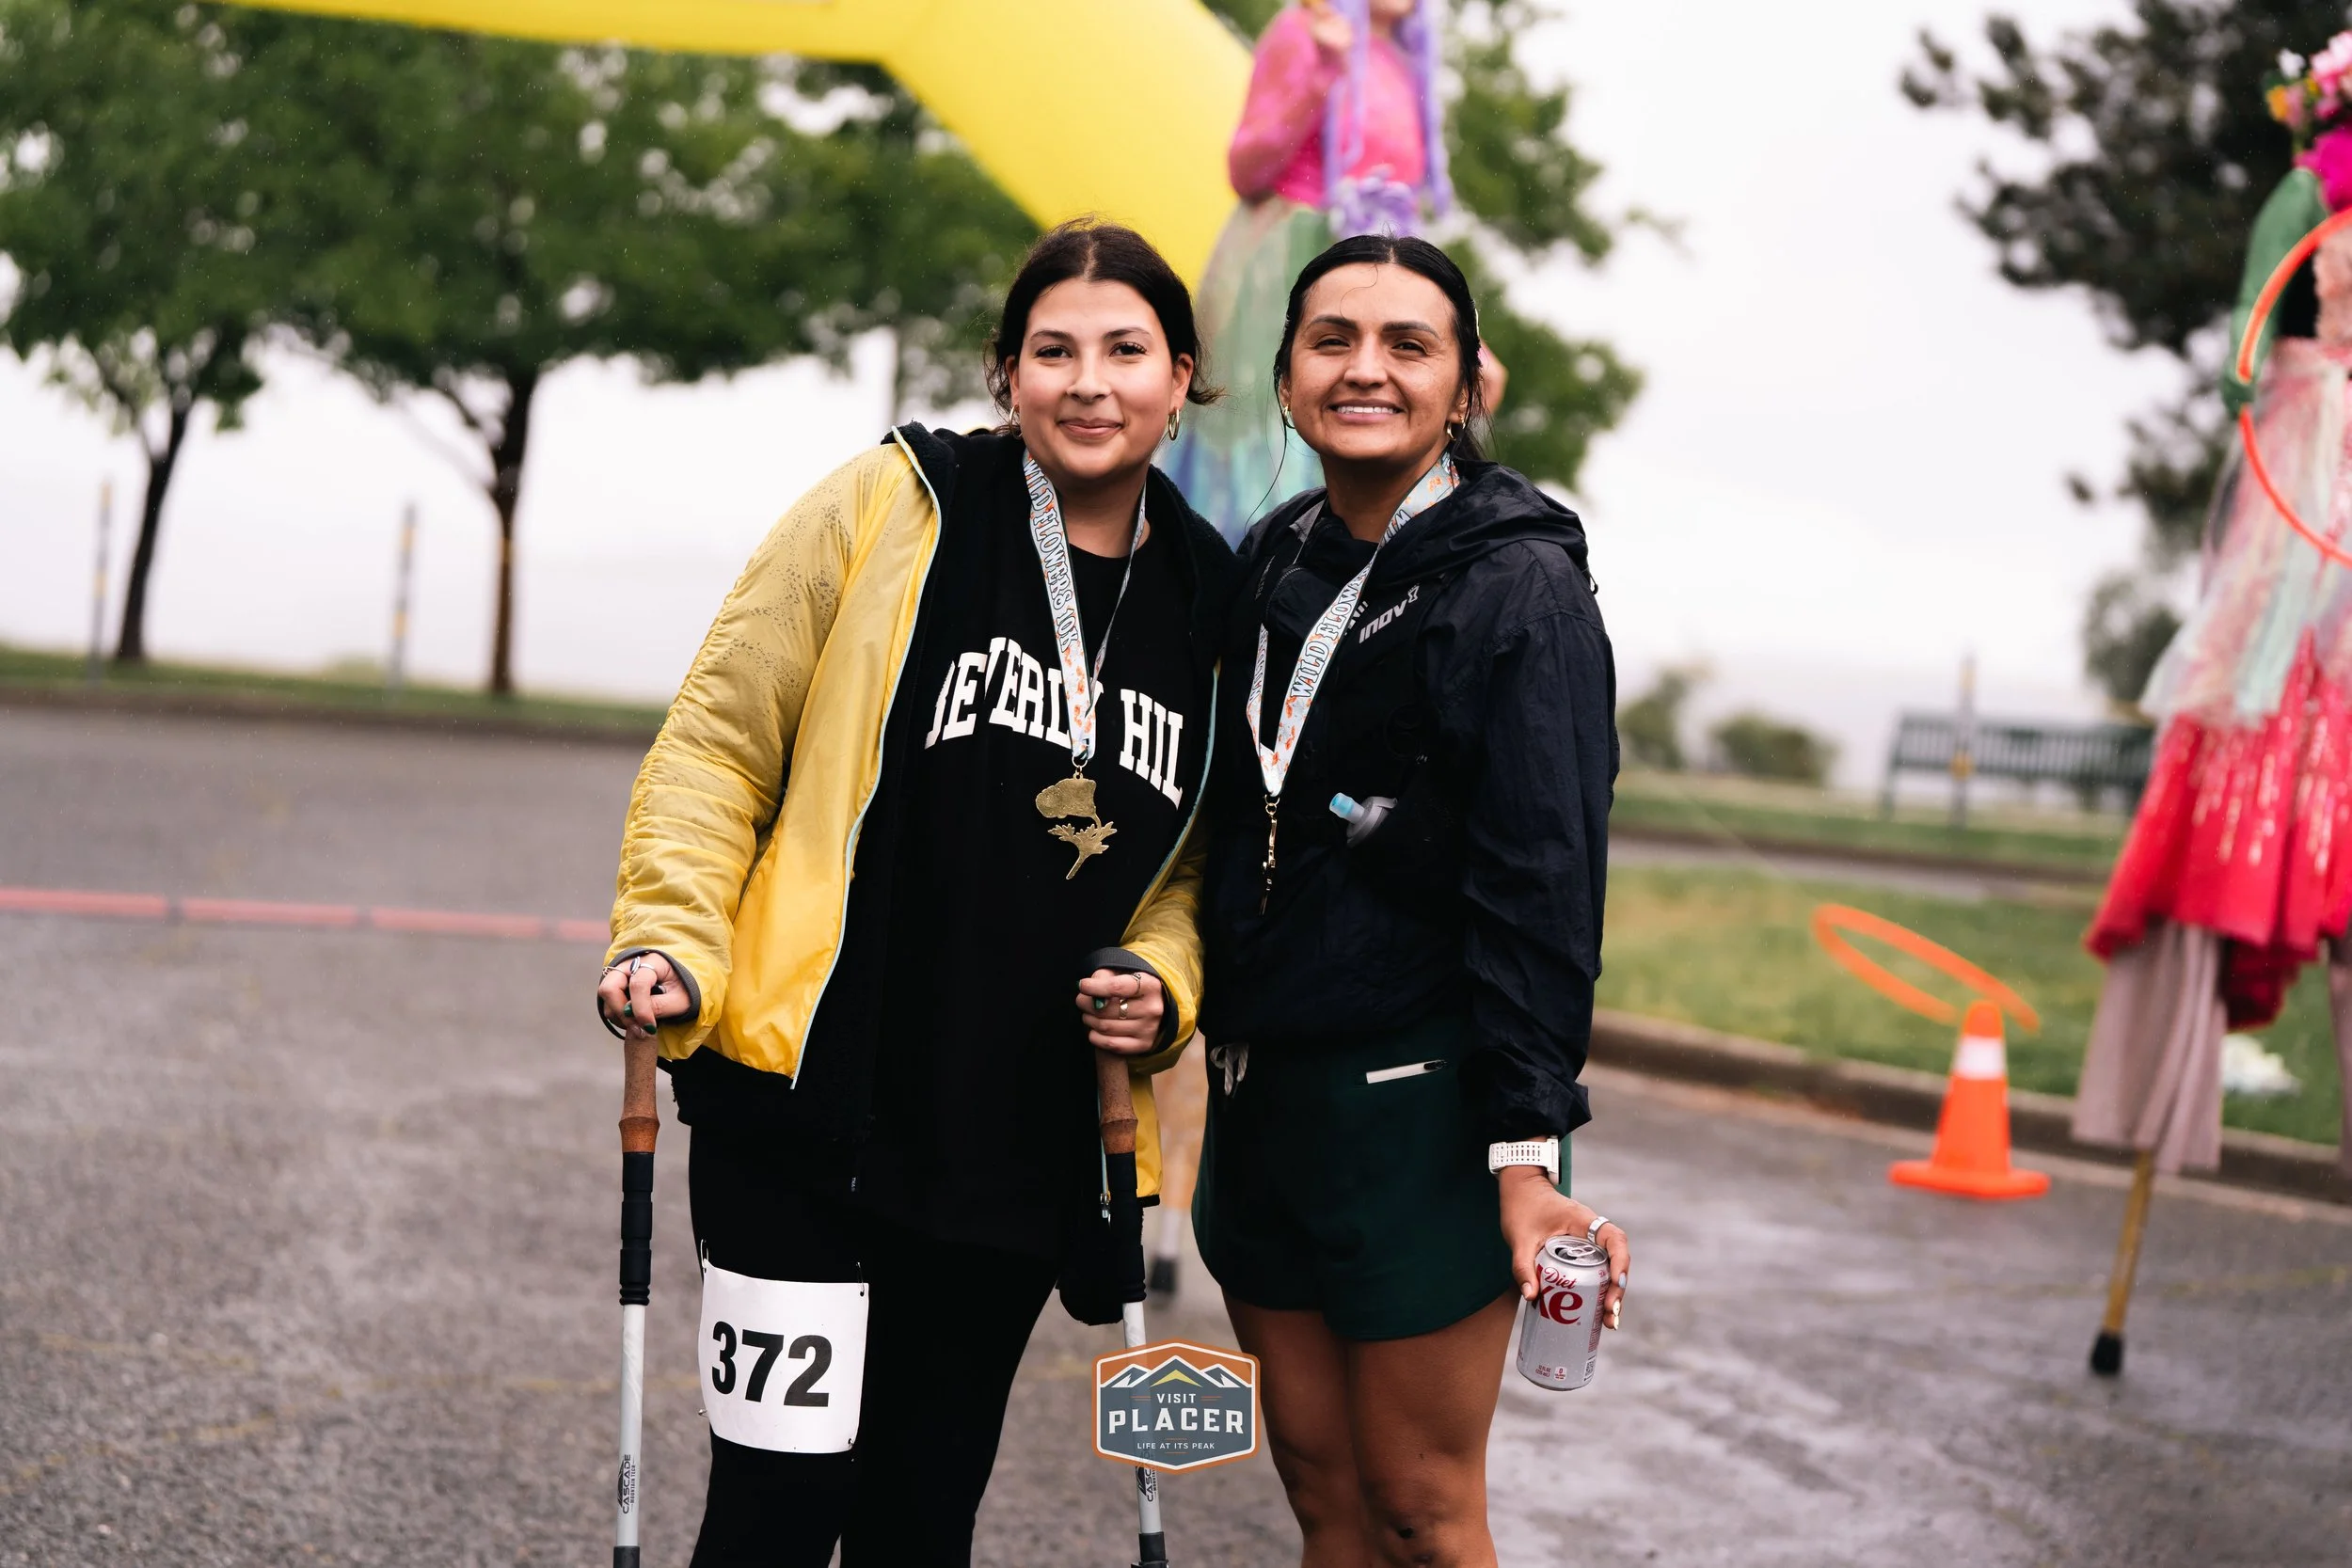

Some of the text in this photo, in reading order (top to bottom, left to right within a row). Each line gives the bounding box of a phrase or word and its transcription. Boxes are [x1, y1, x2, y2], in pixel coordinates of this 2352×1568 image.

[1024, 459, 1079, 653] WILD FLOWERS 10K
[1291, 566, 1369, 698] WILD FLOW
[1544, 1266, 1577, 1289] Diet
[711, 1321, 833, 1408] 372
[623, 1454, 631, 1514] CASCADE
[1145, 1468, 1154, 1502] CASC
